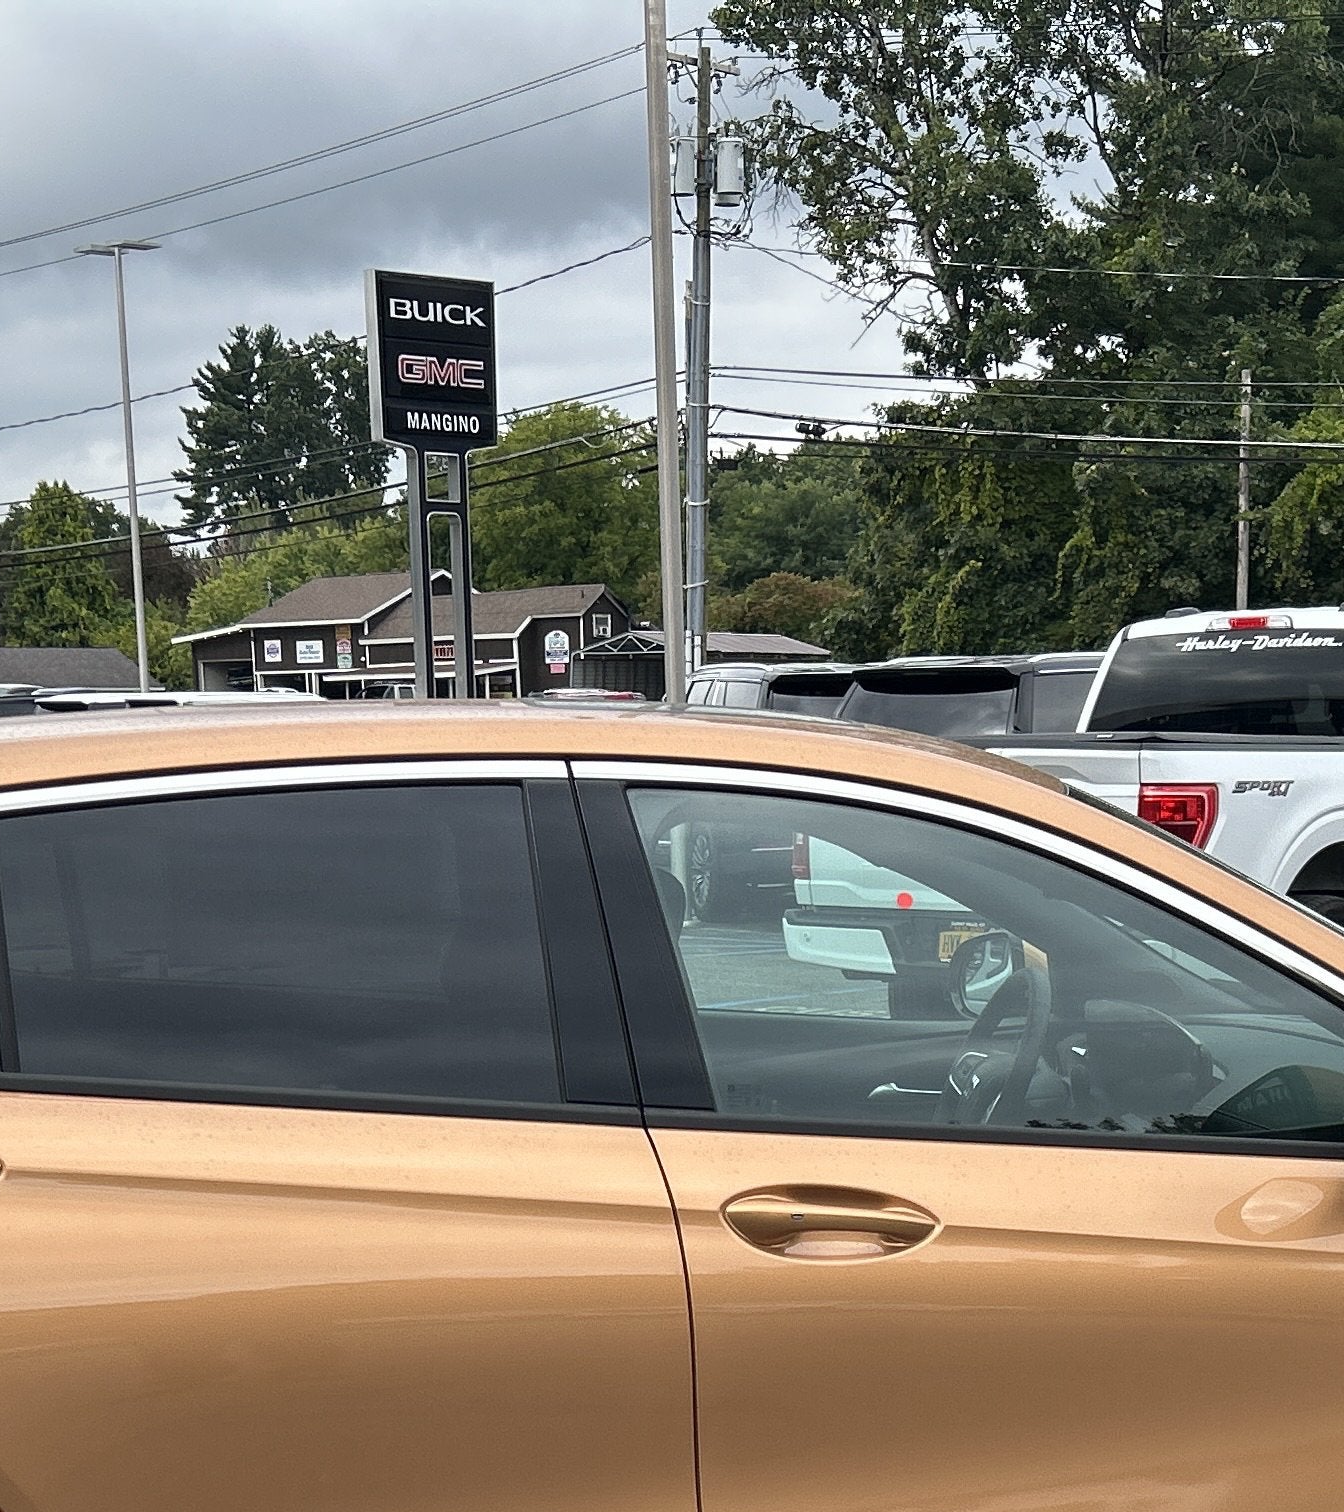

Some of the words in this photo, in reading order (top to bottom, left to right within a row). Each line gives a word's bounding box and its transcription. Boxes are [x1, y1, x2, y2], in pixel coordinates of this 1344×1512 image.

[388, 297, 487, 328] BUICK
[398, 354, 485, 389] GMC
[406, 411, 480, 434] MANGINO
[1175, 632, 1343, 653] Harley-Davidson
[1231, 780, 1295, 797] SPORT
